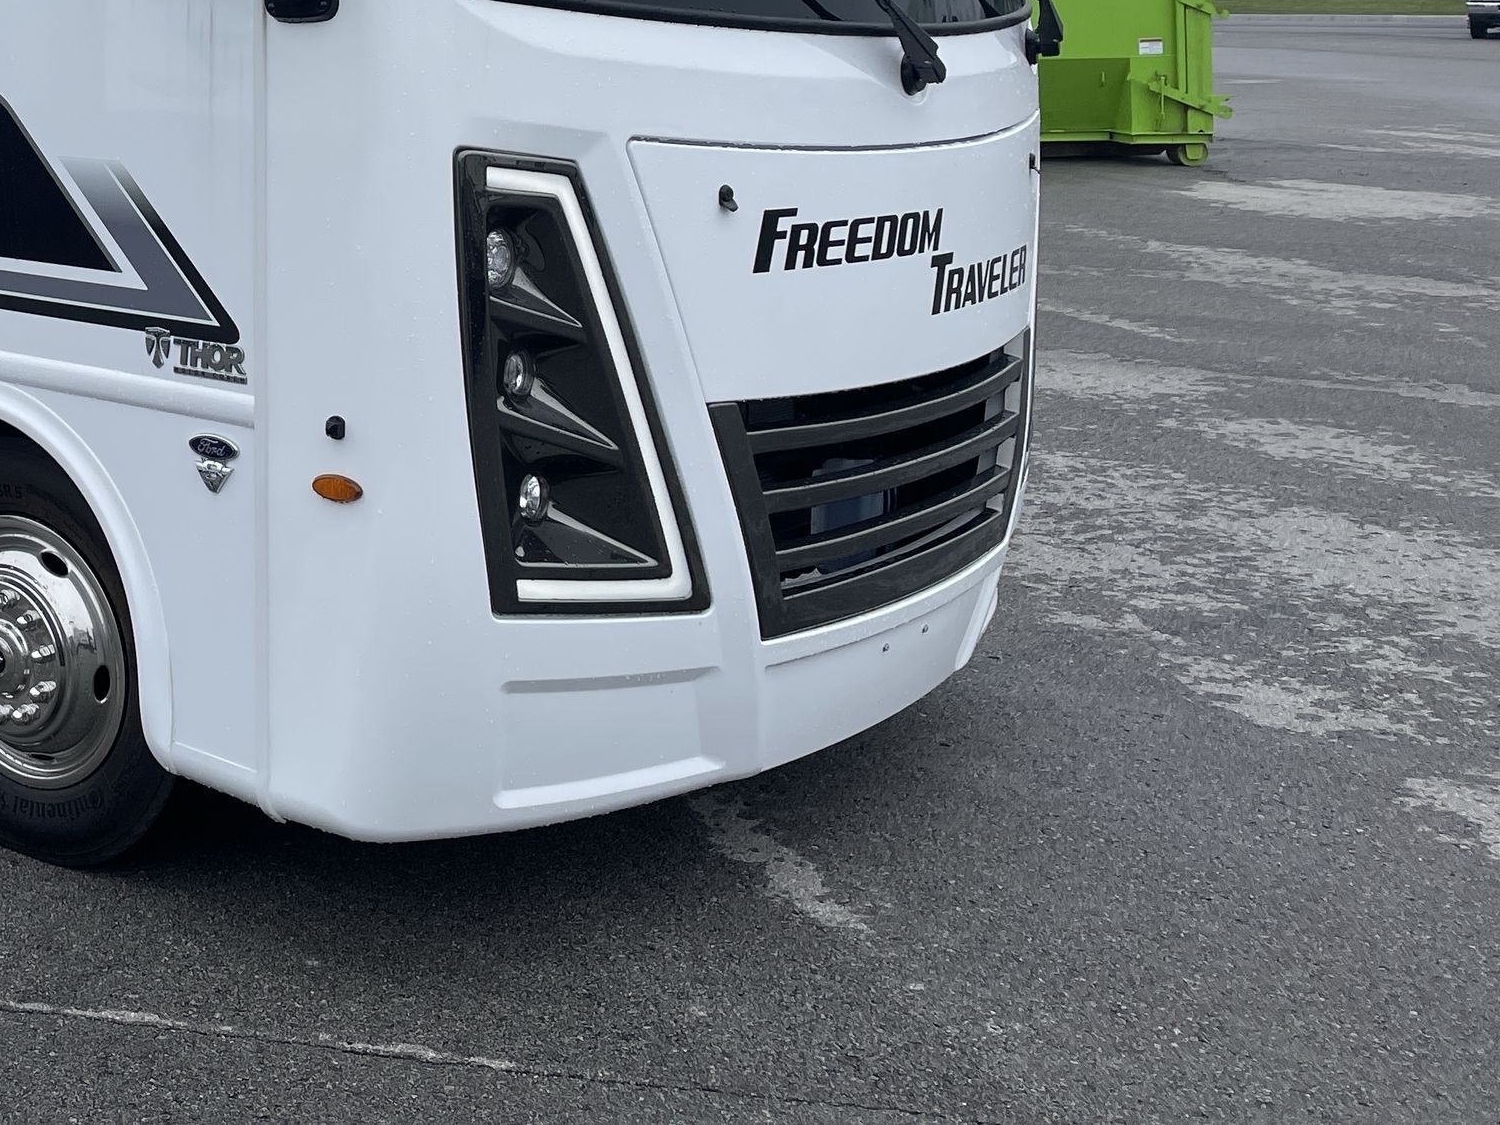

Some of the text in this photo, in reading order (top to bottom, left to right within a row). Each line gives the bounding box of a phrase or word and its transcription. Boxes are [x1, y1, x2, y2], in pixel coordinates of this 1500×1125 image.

[752, 207, 943, 274] FREEDOM
[930, 244, 1027, 315] TRAVELER
[173, 338, 247, 376] THOR
[197, 438, 226, 457] Ford
